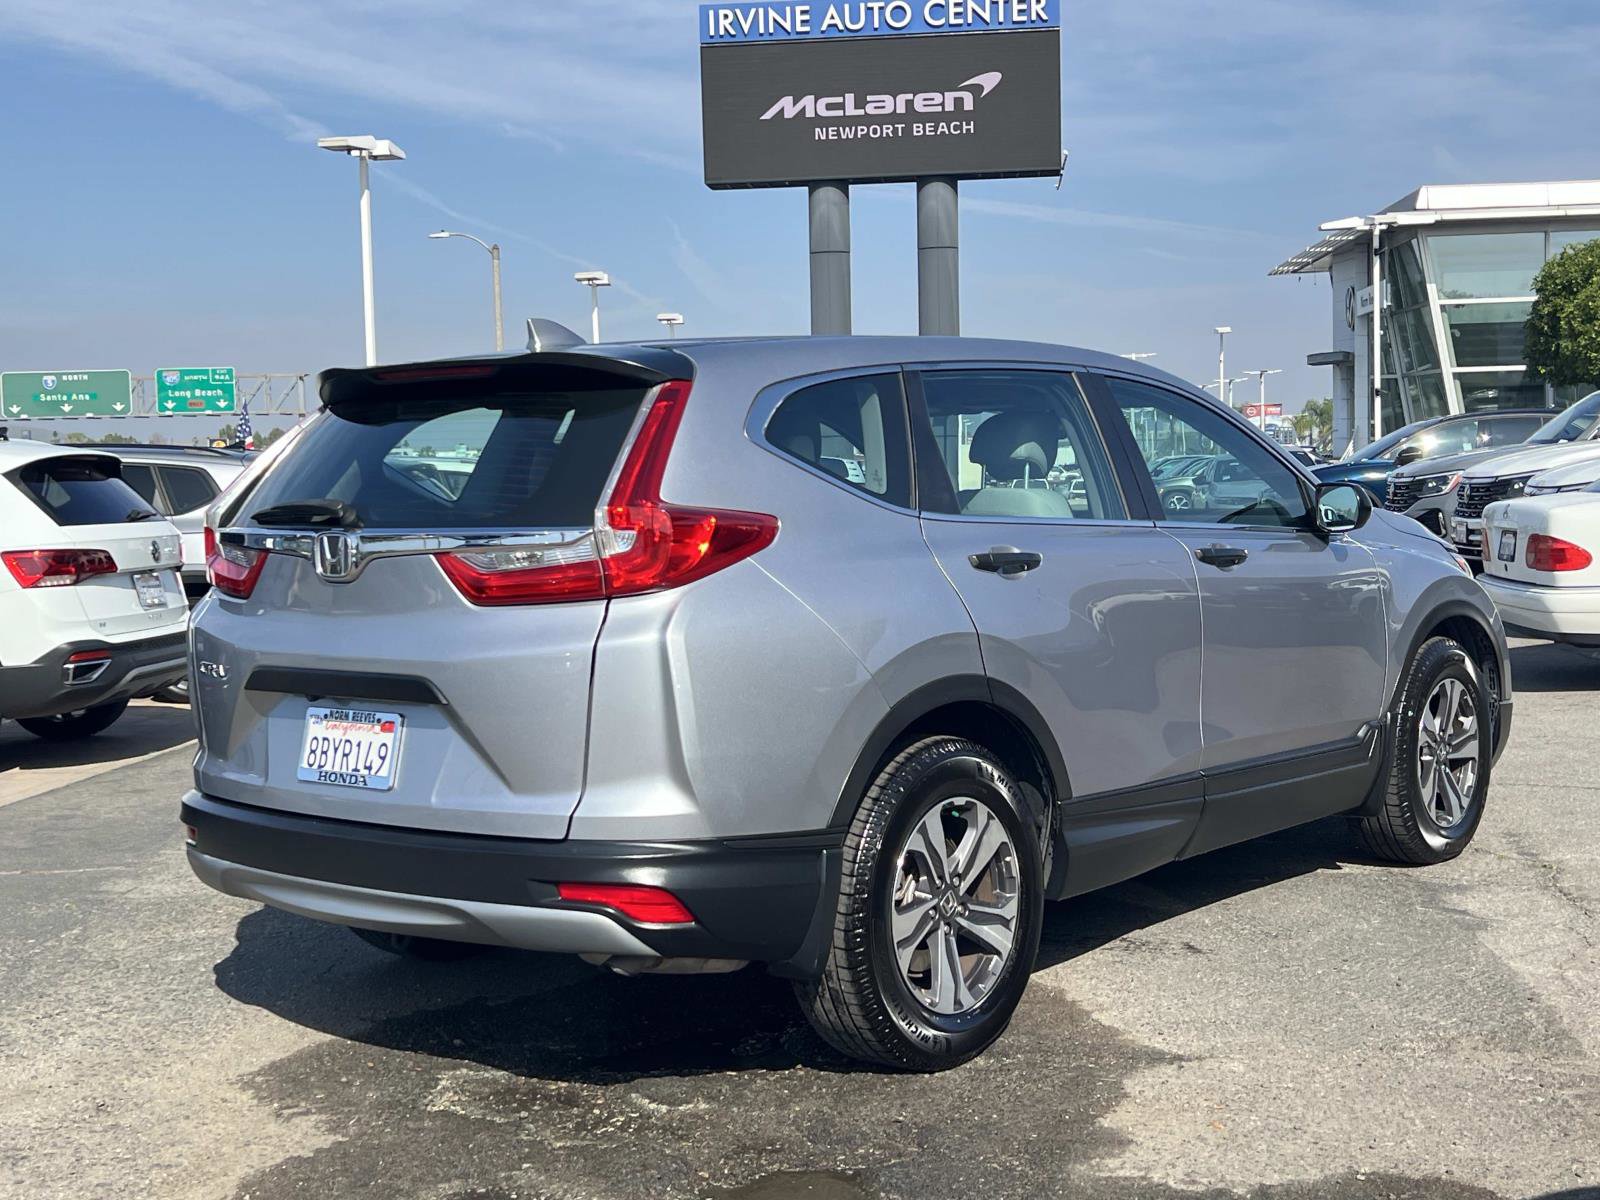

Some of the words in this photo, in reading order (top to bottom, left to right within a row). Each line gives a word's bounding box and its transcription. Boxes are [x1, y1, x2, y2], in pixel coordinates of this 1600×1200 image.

[708, 5, 811, 37] IRVINE
[821, 0, 912, 32] AUTO
[923, 0, 1049, 27] CENTER
[760, 91, 974, 119] McLaren
[814, 124, 905, 141] NEWPORT
[913, 121, 976, 137] BEACH
[39, 393, 68, 402] Santa
[71, 393, 90, 401] Ana
[168, 389, 191, 399] Long
[194, 388, 223, 398] Beach
[329, 710, 350, 721] NORM
[351, 711, 377, 724] REEVES
[307, 736, 389, 775] 8BYR149
[317, 770, 369, 786] HONDA
